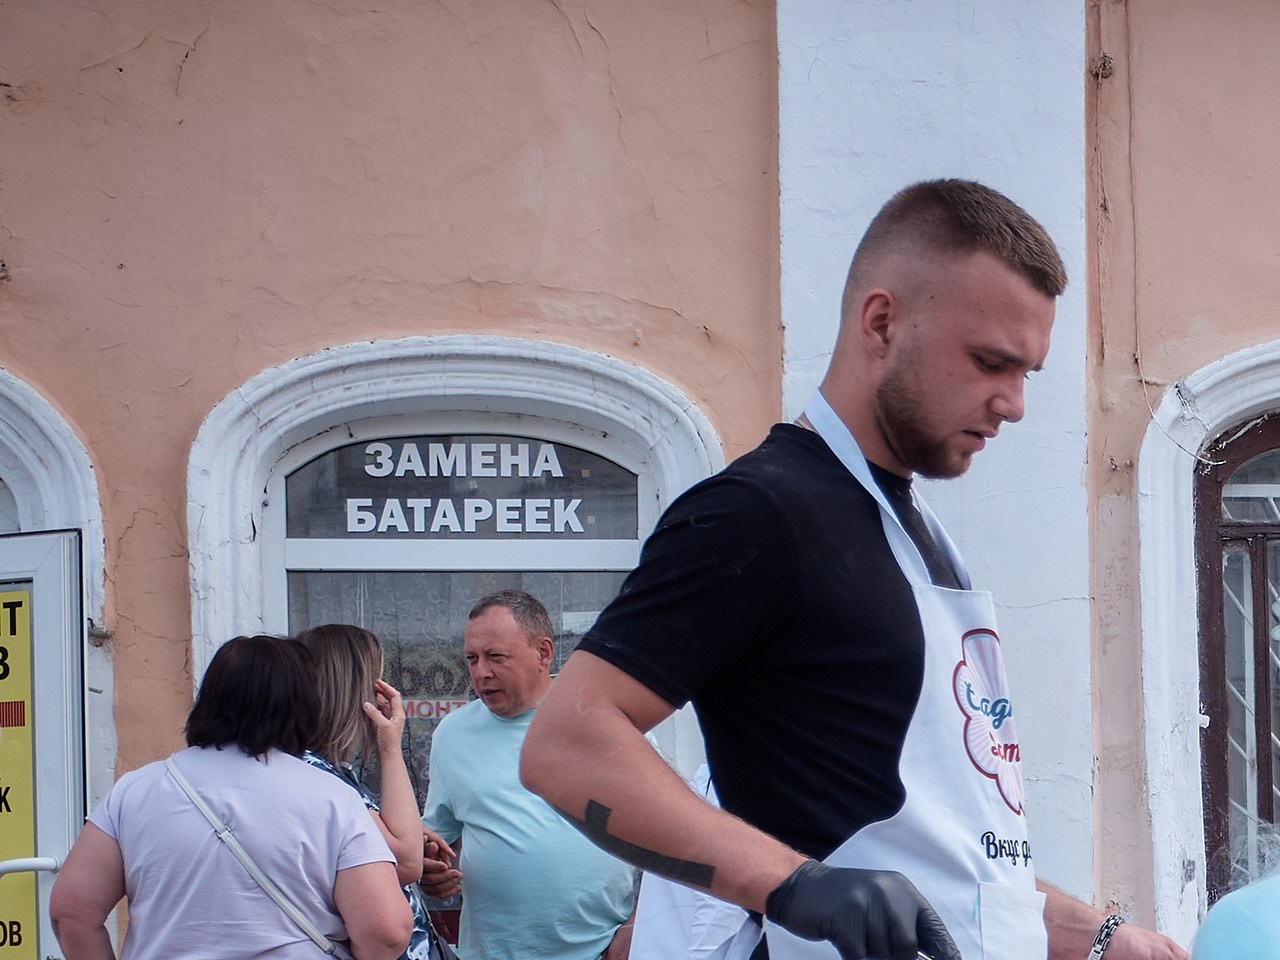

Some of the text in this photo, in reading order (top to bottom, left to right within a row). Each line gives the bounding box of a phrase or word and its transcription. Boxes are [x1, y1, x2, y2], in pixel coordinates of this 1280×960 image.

[364, 442, 564, 478] ЗАМЕНА
[346, 498, 585, 533] БАТАРЕЕК
[981, 831, 1020, 866] Вкус
